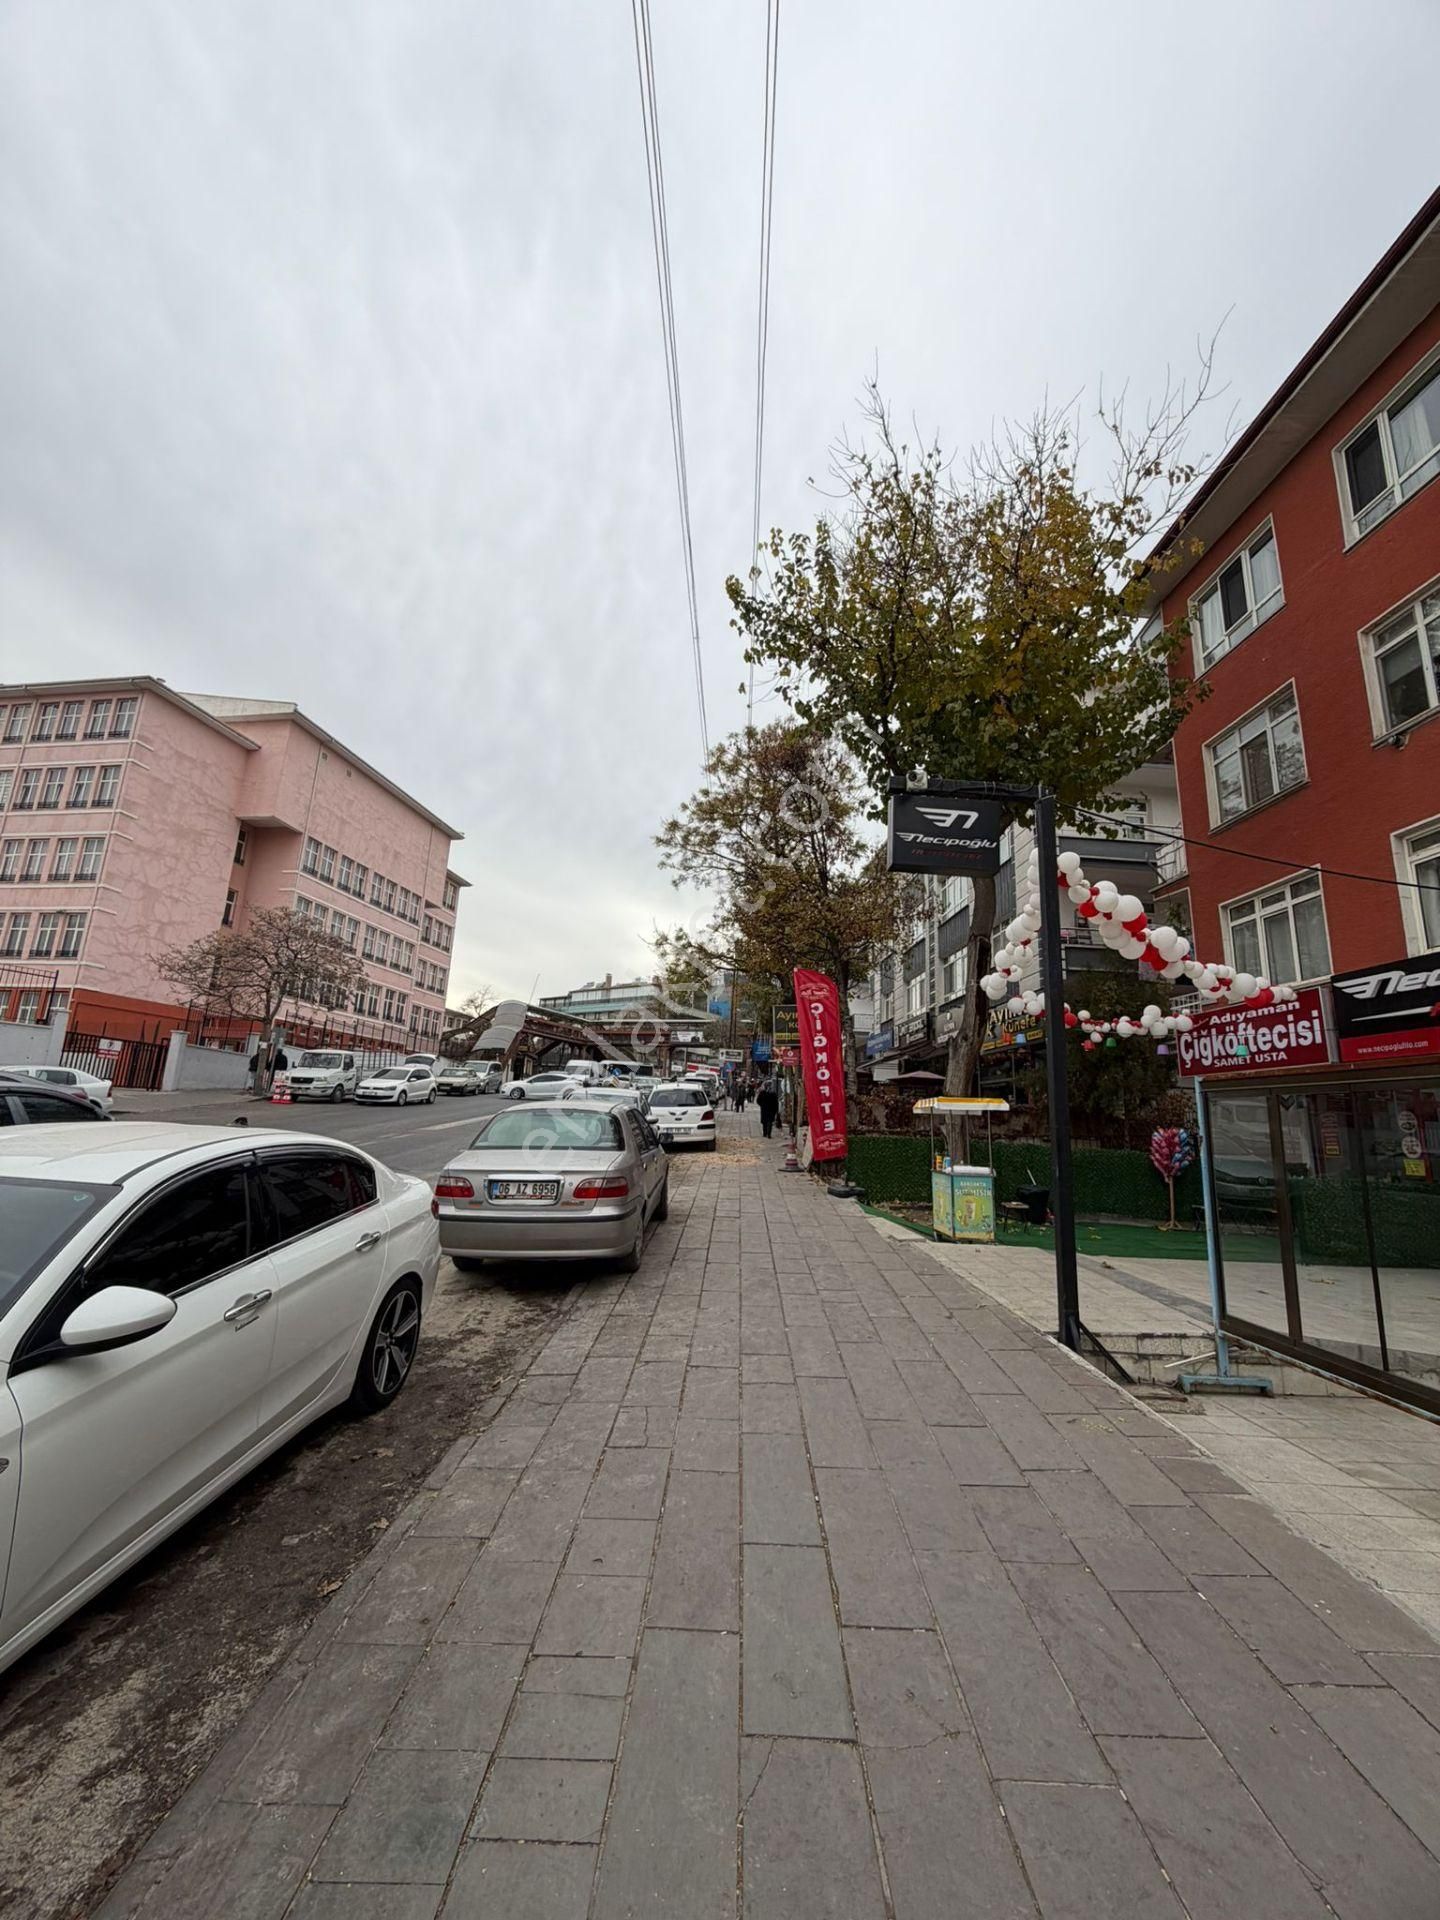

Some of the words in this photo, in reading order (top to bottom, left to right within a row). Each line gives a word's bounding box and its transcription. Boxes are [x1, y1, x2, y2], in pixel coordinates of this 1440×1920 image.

[1209, 1000, 1300, 1026] Adıyaman
[1179, 1009, 1323, 1069] Çiğköftecisi
[1213, 1055, 1251, 1068] SAMET
[1255, 1051, 1288, 1064] USTA
[499, 1183, 510, 1194] 06
[516, 1183, 528, 1194] AZ
[532, 1183, 556, 1195] 6958
